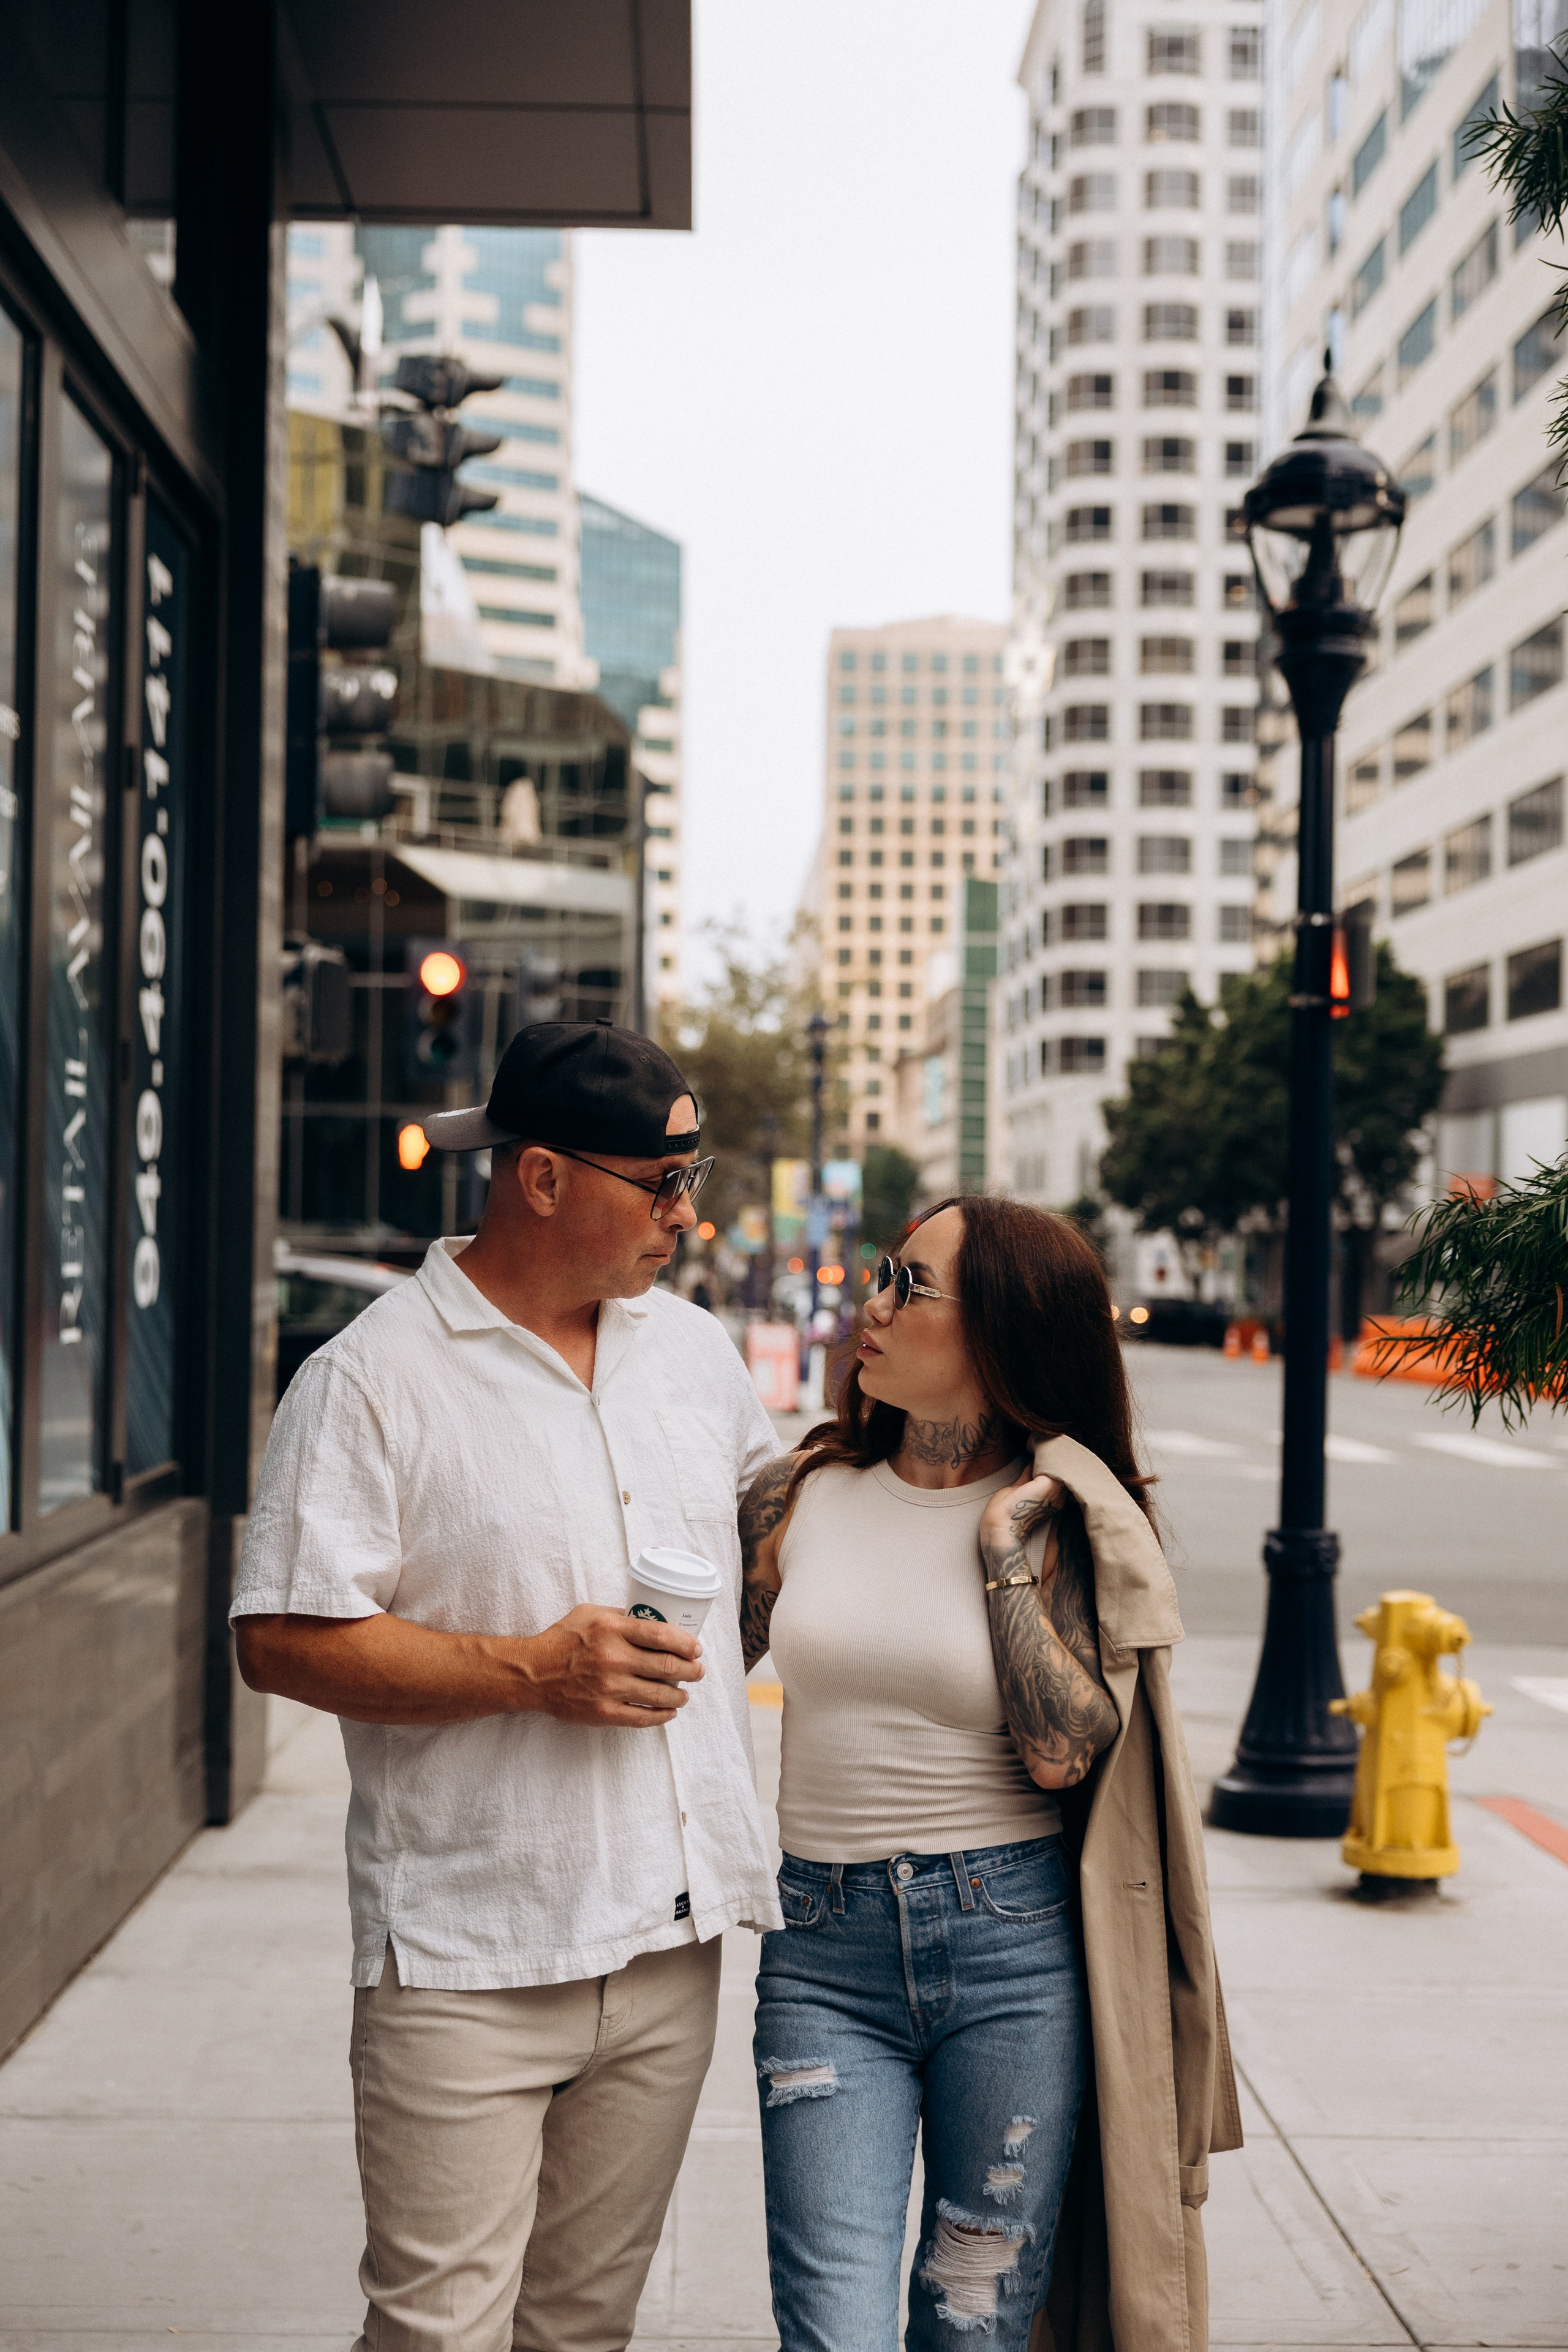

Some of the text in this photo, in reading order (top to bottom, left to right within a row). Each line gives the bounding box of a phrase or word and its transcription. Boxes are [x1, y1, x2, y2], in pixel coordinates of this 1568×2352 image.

[59, 522, 99, 1345] RETAIL AVAILABLE
[133, 552, 174, 1310] 949.490.1411
